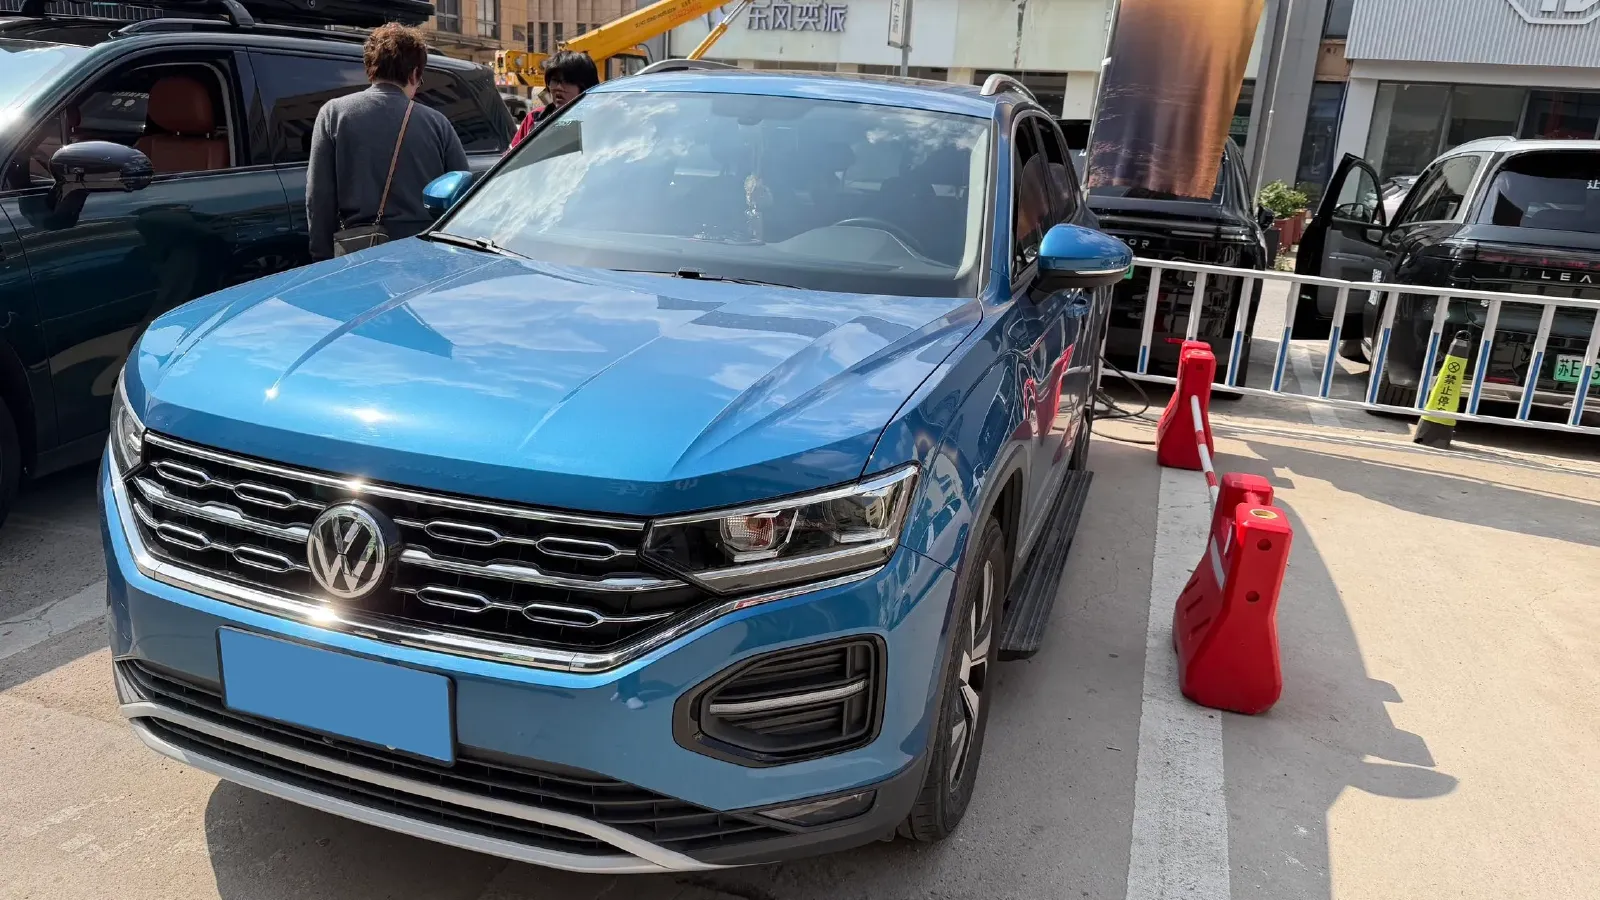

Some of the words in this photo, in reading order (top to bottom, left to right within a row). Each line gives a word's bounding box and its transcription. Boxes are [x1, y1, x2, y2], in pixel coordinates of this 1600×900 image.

[747, 3, 848, 32] 东风奕派
[309, 507, 382, 596] VW
